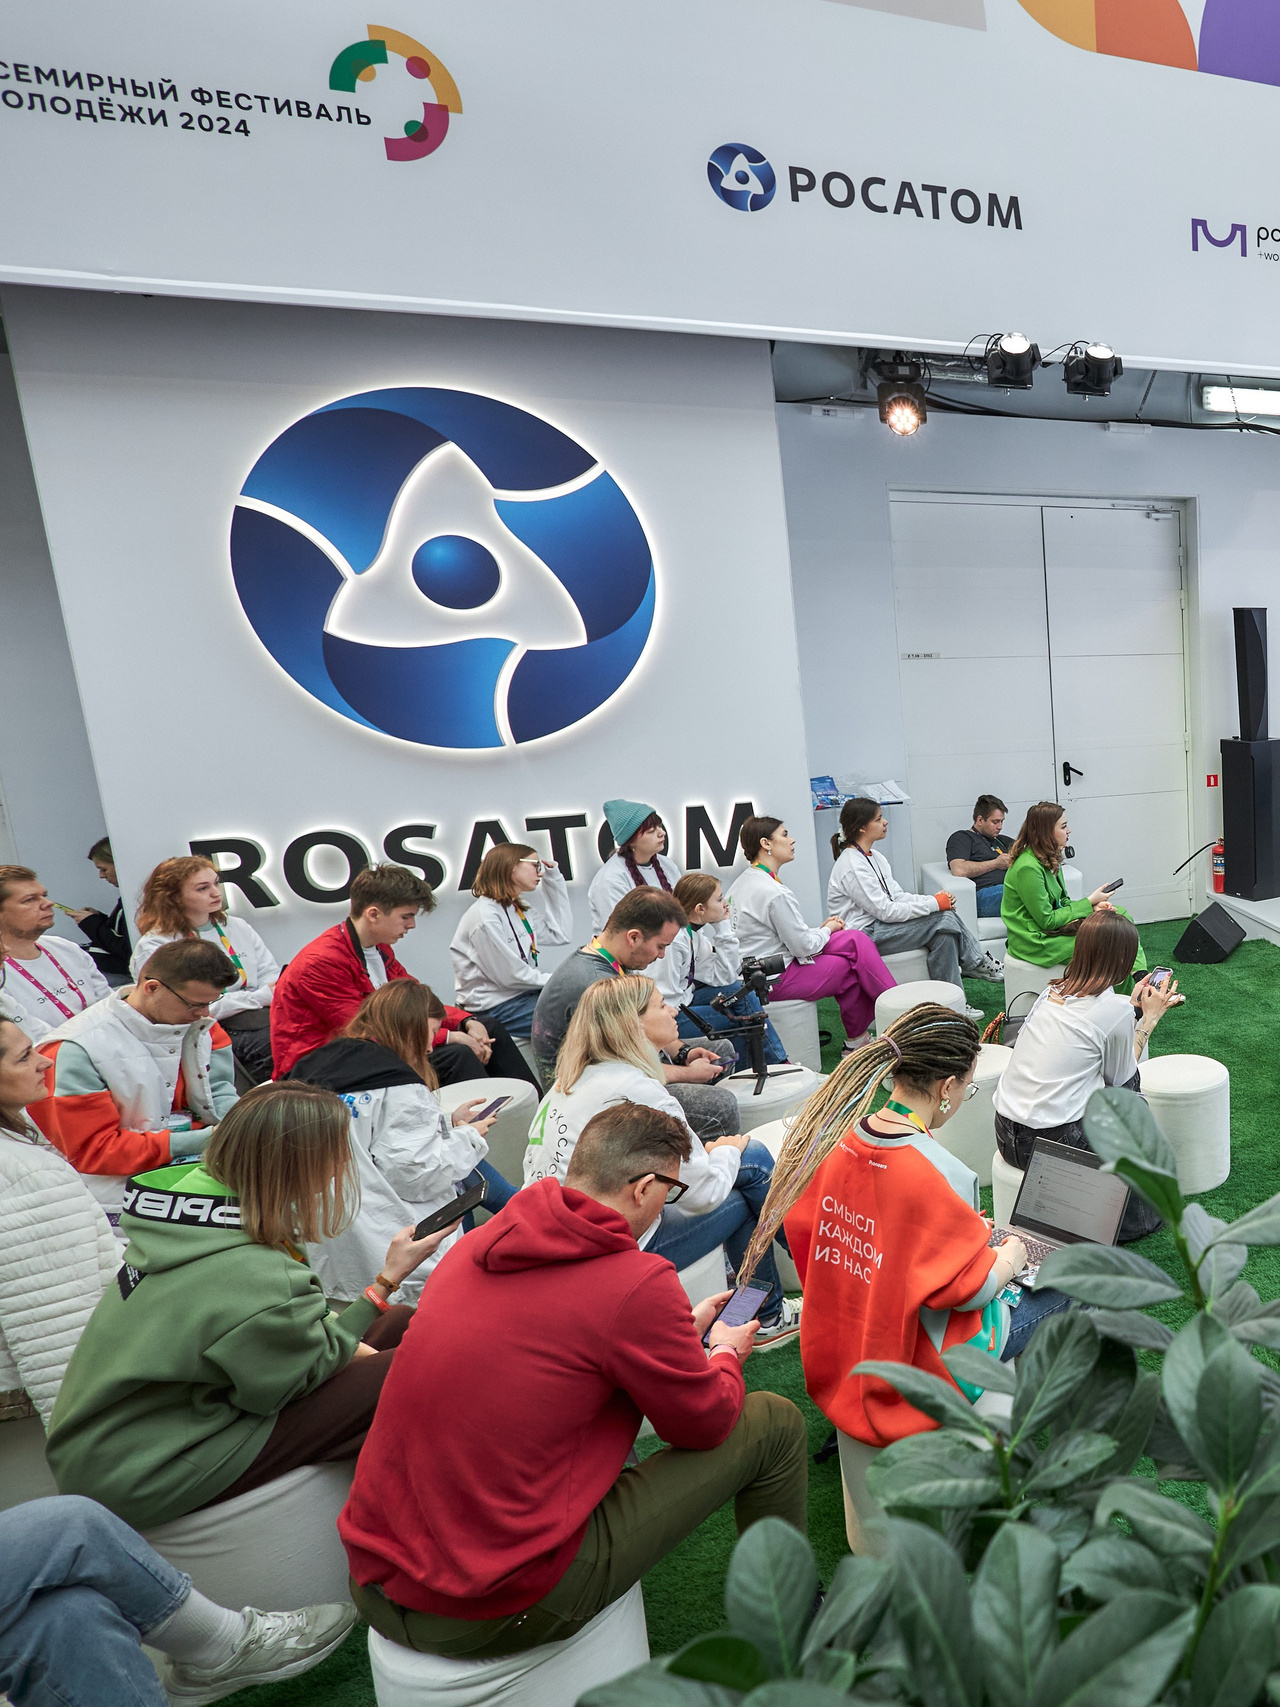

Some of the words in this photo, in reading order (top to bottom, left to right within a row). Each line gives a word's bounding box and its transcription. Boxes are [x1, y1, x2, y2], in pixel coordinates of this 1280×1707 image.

[179, 112, 251, 137] 2024
[190, 87, 372, 126] ФЕСТИВАЛЬ
[788, 165, 1023, 230] РОСАТОМ
[821, 1195, 875, 1236] СМЫСЛ
[814, 1244, 841, 1265] ИЗ
[844, 1254, 872, 1284] НАС
[818, 1220, 883, 1269] КАЖДОМ
